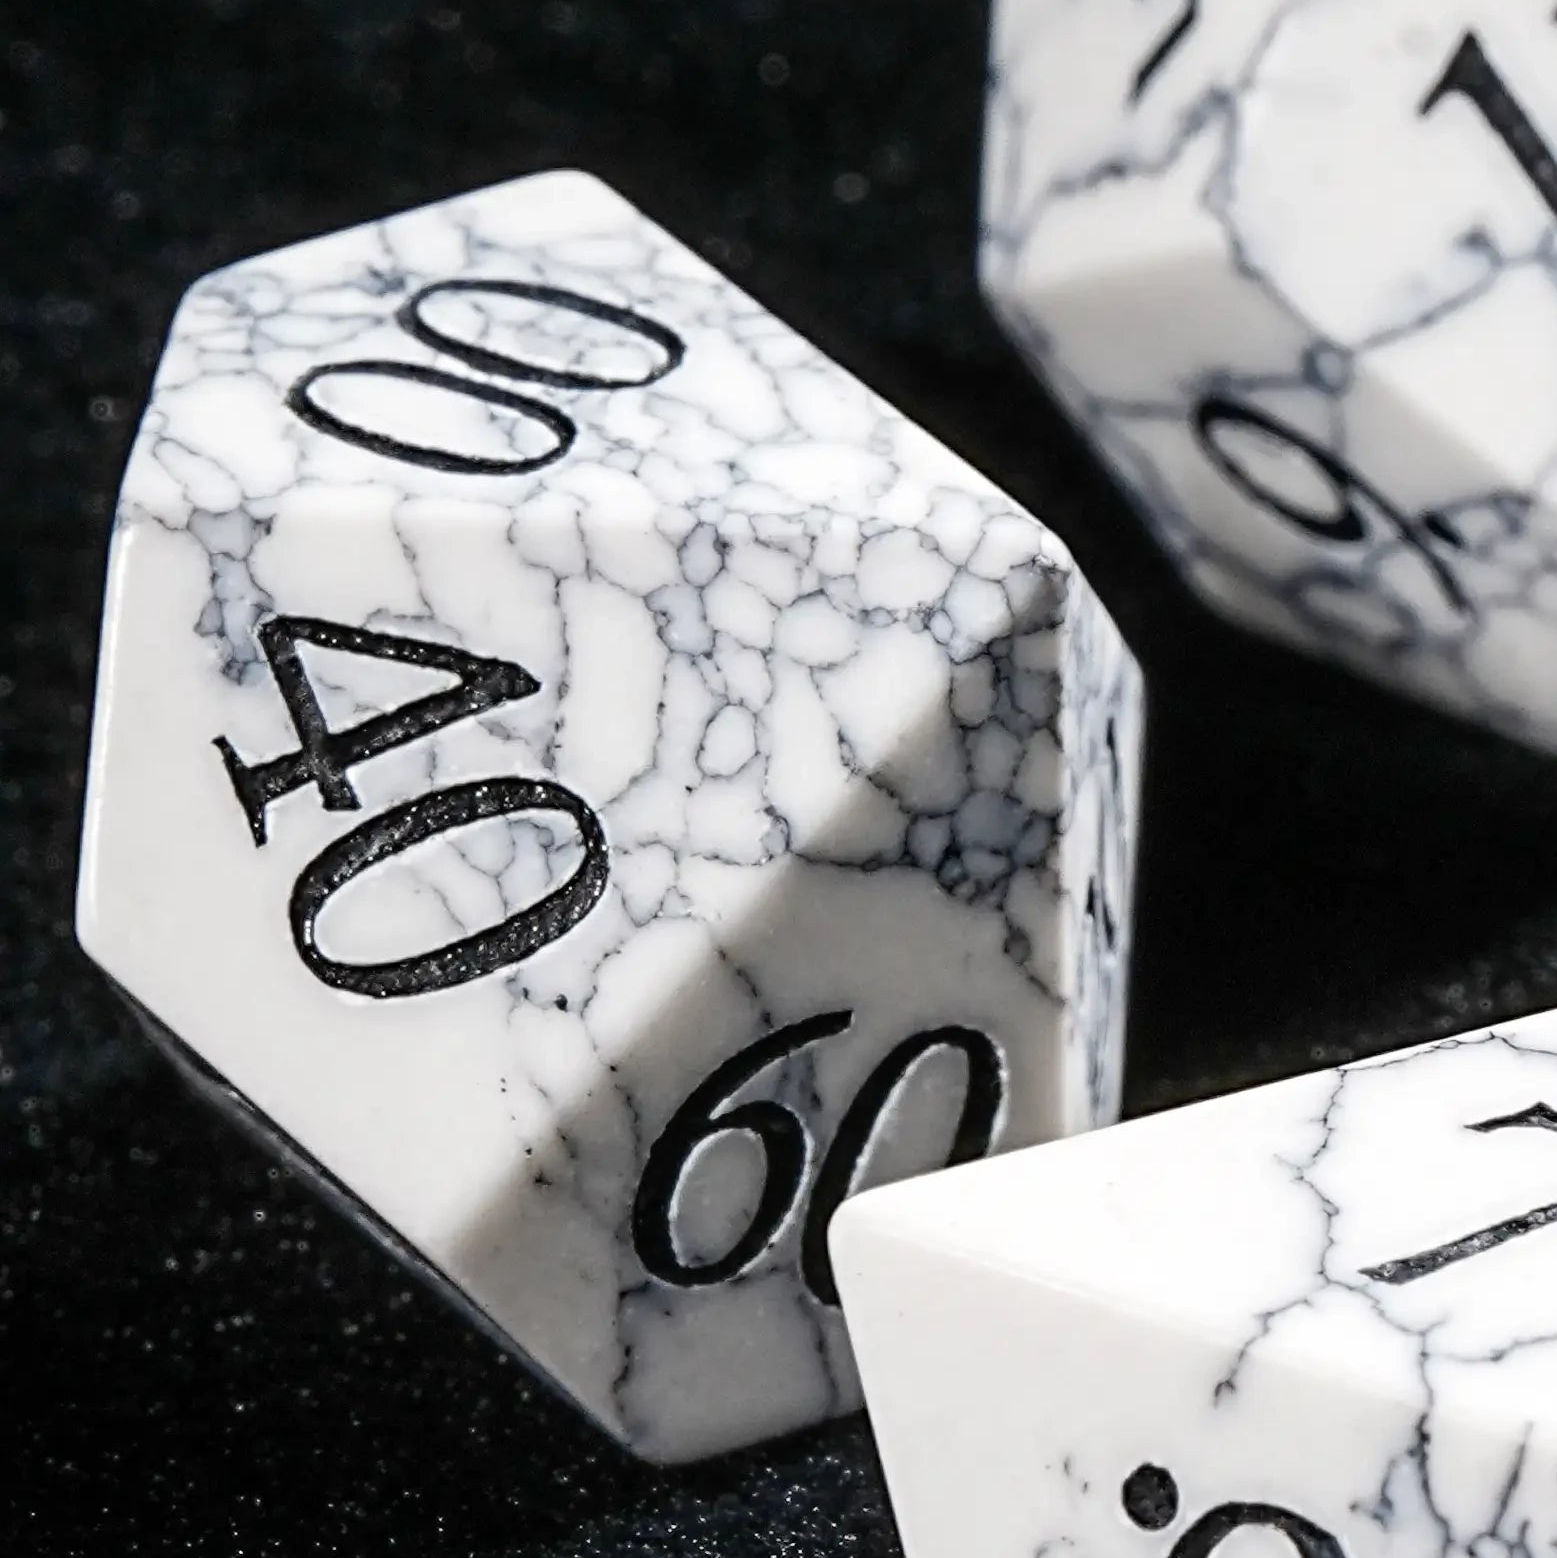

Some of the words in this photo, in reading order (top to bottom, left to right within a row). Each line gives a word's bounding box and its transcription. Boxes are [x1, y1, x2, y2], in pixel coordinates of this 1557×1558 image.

[286, 277, 687, 479] 00
[211, 613, 611, 1001] 40
[629, 1008, 1004, 1311] 60
